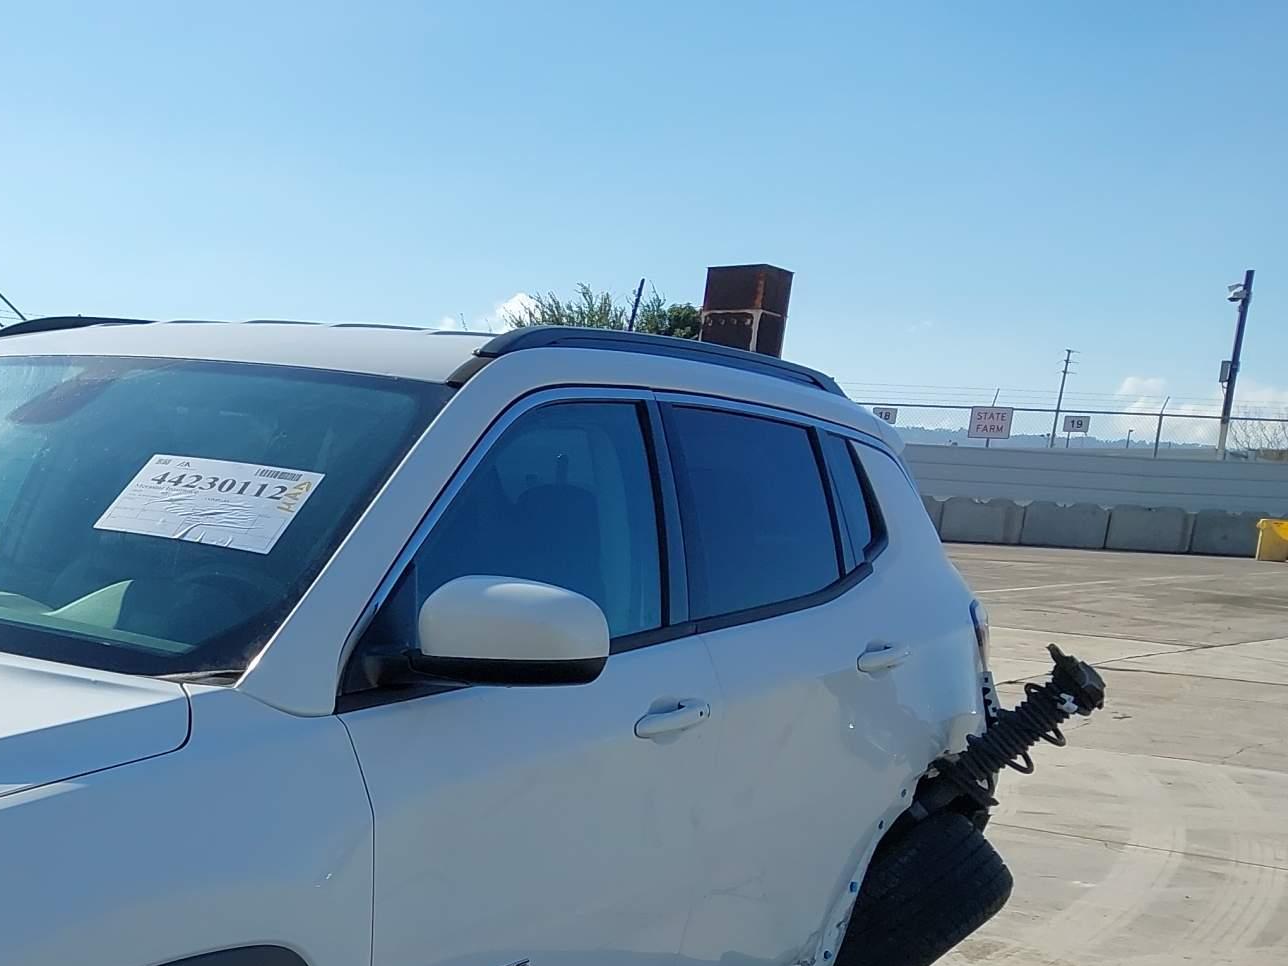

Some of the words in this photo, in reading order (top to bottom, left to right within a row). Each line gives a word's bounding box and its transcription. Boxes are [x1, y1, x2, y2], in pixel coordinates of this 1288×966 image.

[976, 411, 1008, 422] STATE
[975, 423, 1004, 433] FARM
[1070, 419, 1083, 429] 19
[151, 471, 288, 501] 44230112
